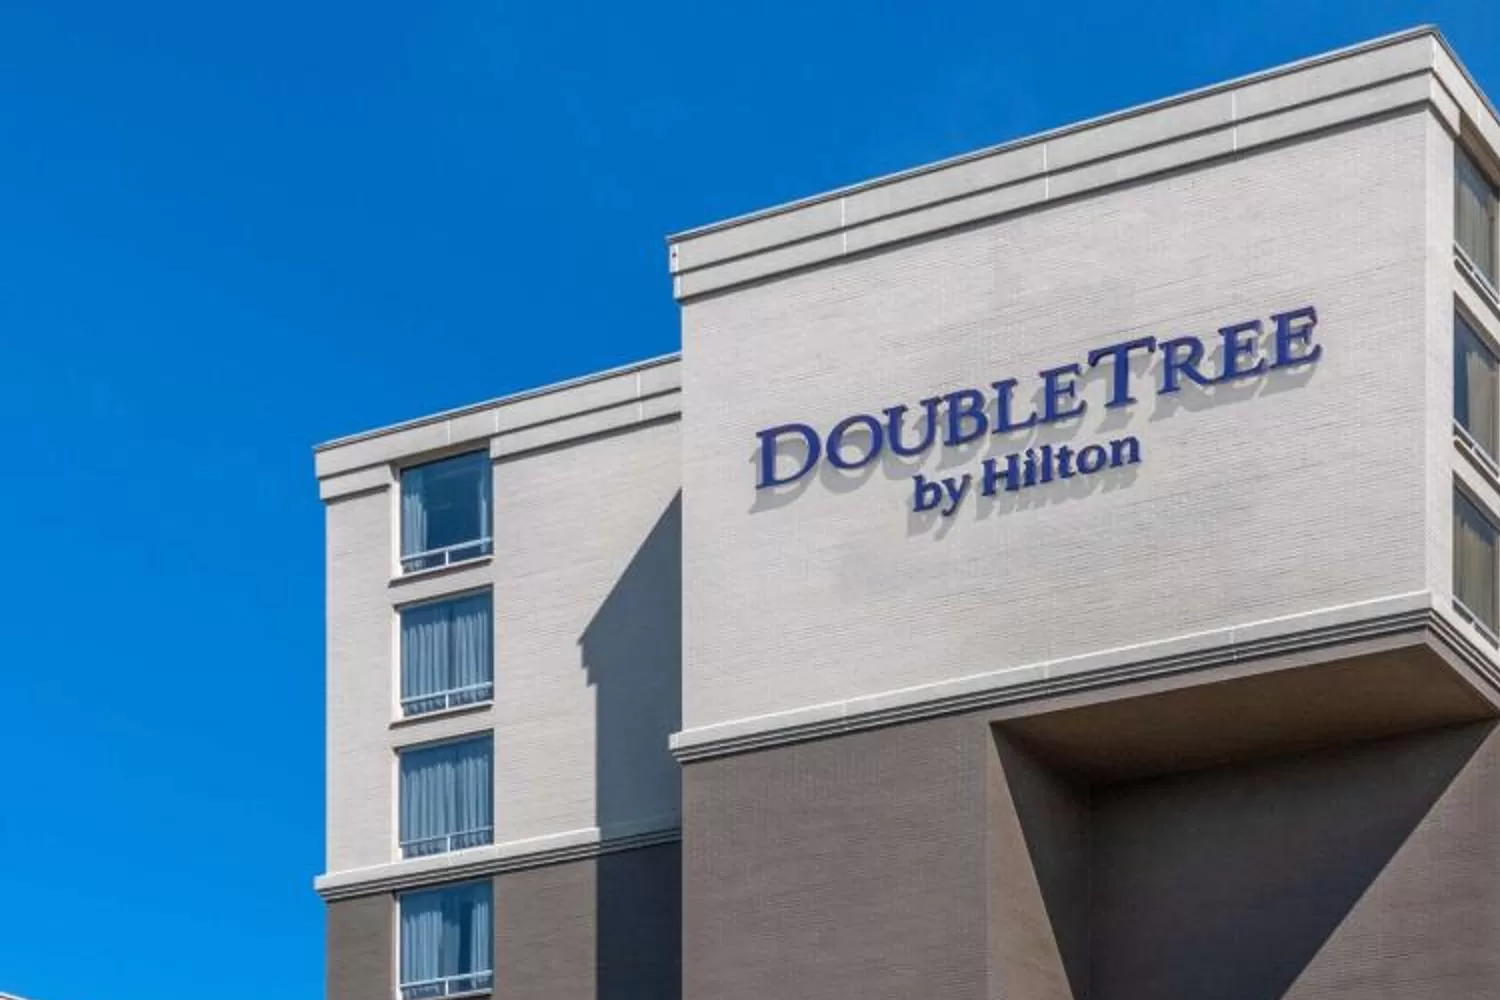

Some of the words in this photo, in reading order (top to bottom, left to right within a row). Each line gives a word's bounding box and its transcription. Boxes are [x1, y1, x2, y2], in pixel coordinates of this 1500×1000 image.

[755, 305, 1322, 490] DOUBLETREE
[912, 474, 970, 516] by
[982, 434, 1141, 498] Hilton
